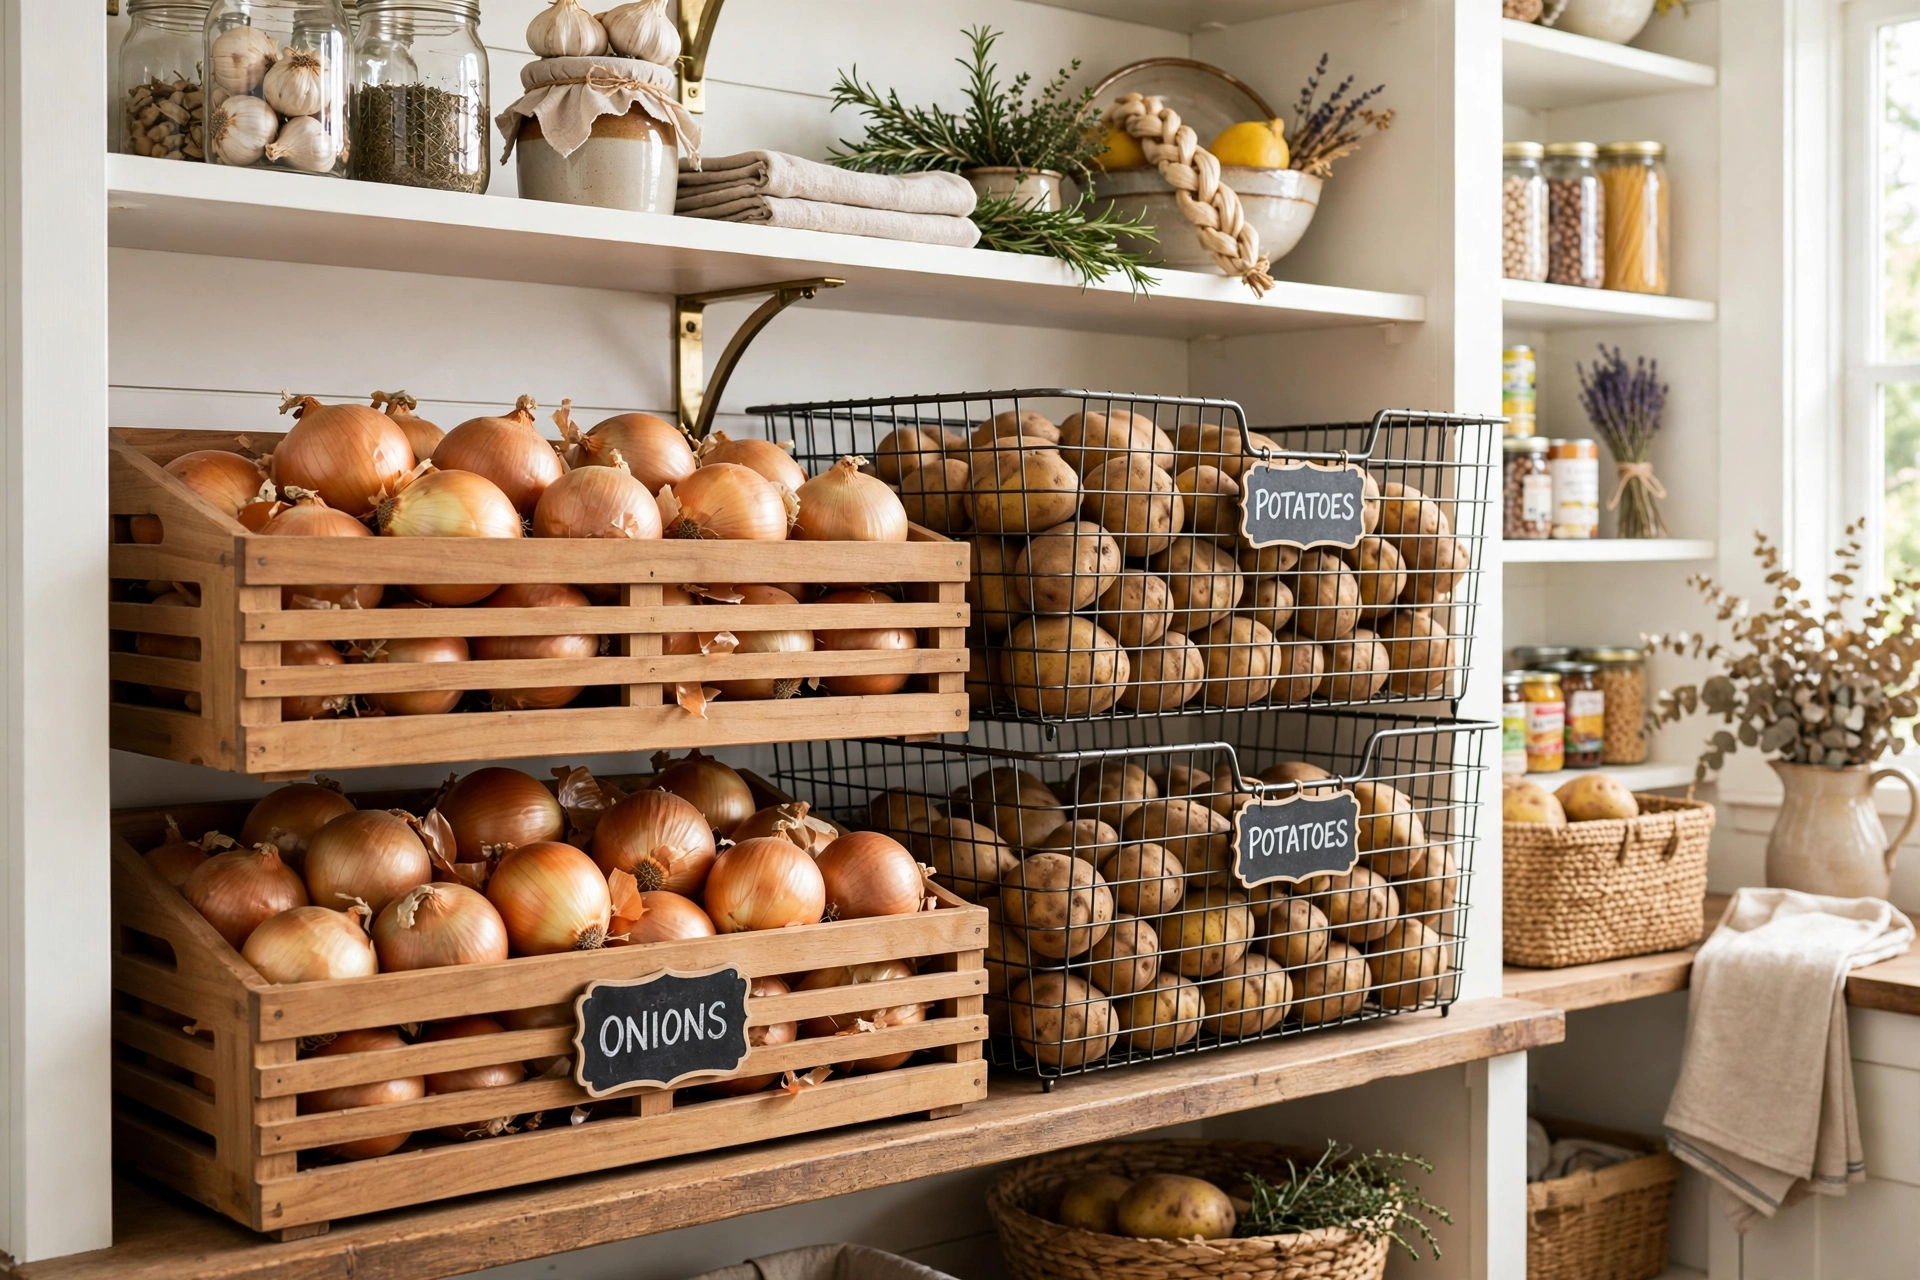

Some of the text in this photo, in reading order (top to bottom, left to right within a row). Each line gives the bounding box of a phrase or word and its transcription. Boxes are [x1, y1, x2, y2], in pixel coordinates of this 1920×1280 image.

[1255, 488, 1354, 521] POTATOES
[1248, 819, 1348, 859] POTATOES
[599, 1001, 727, 1057] ONIONS
